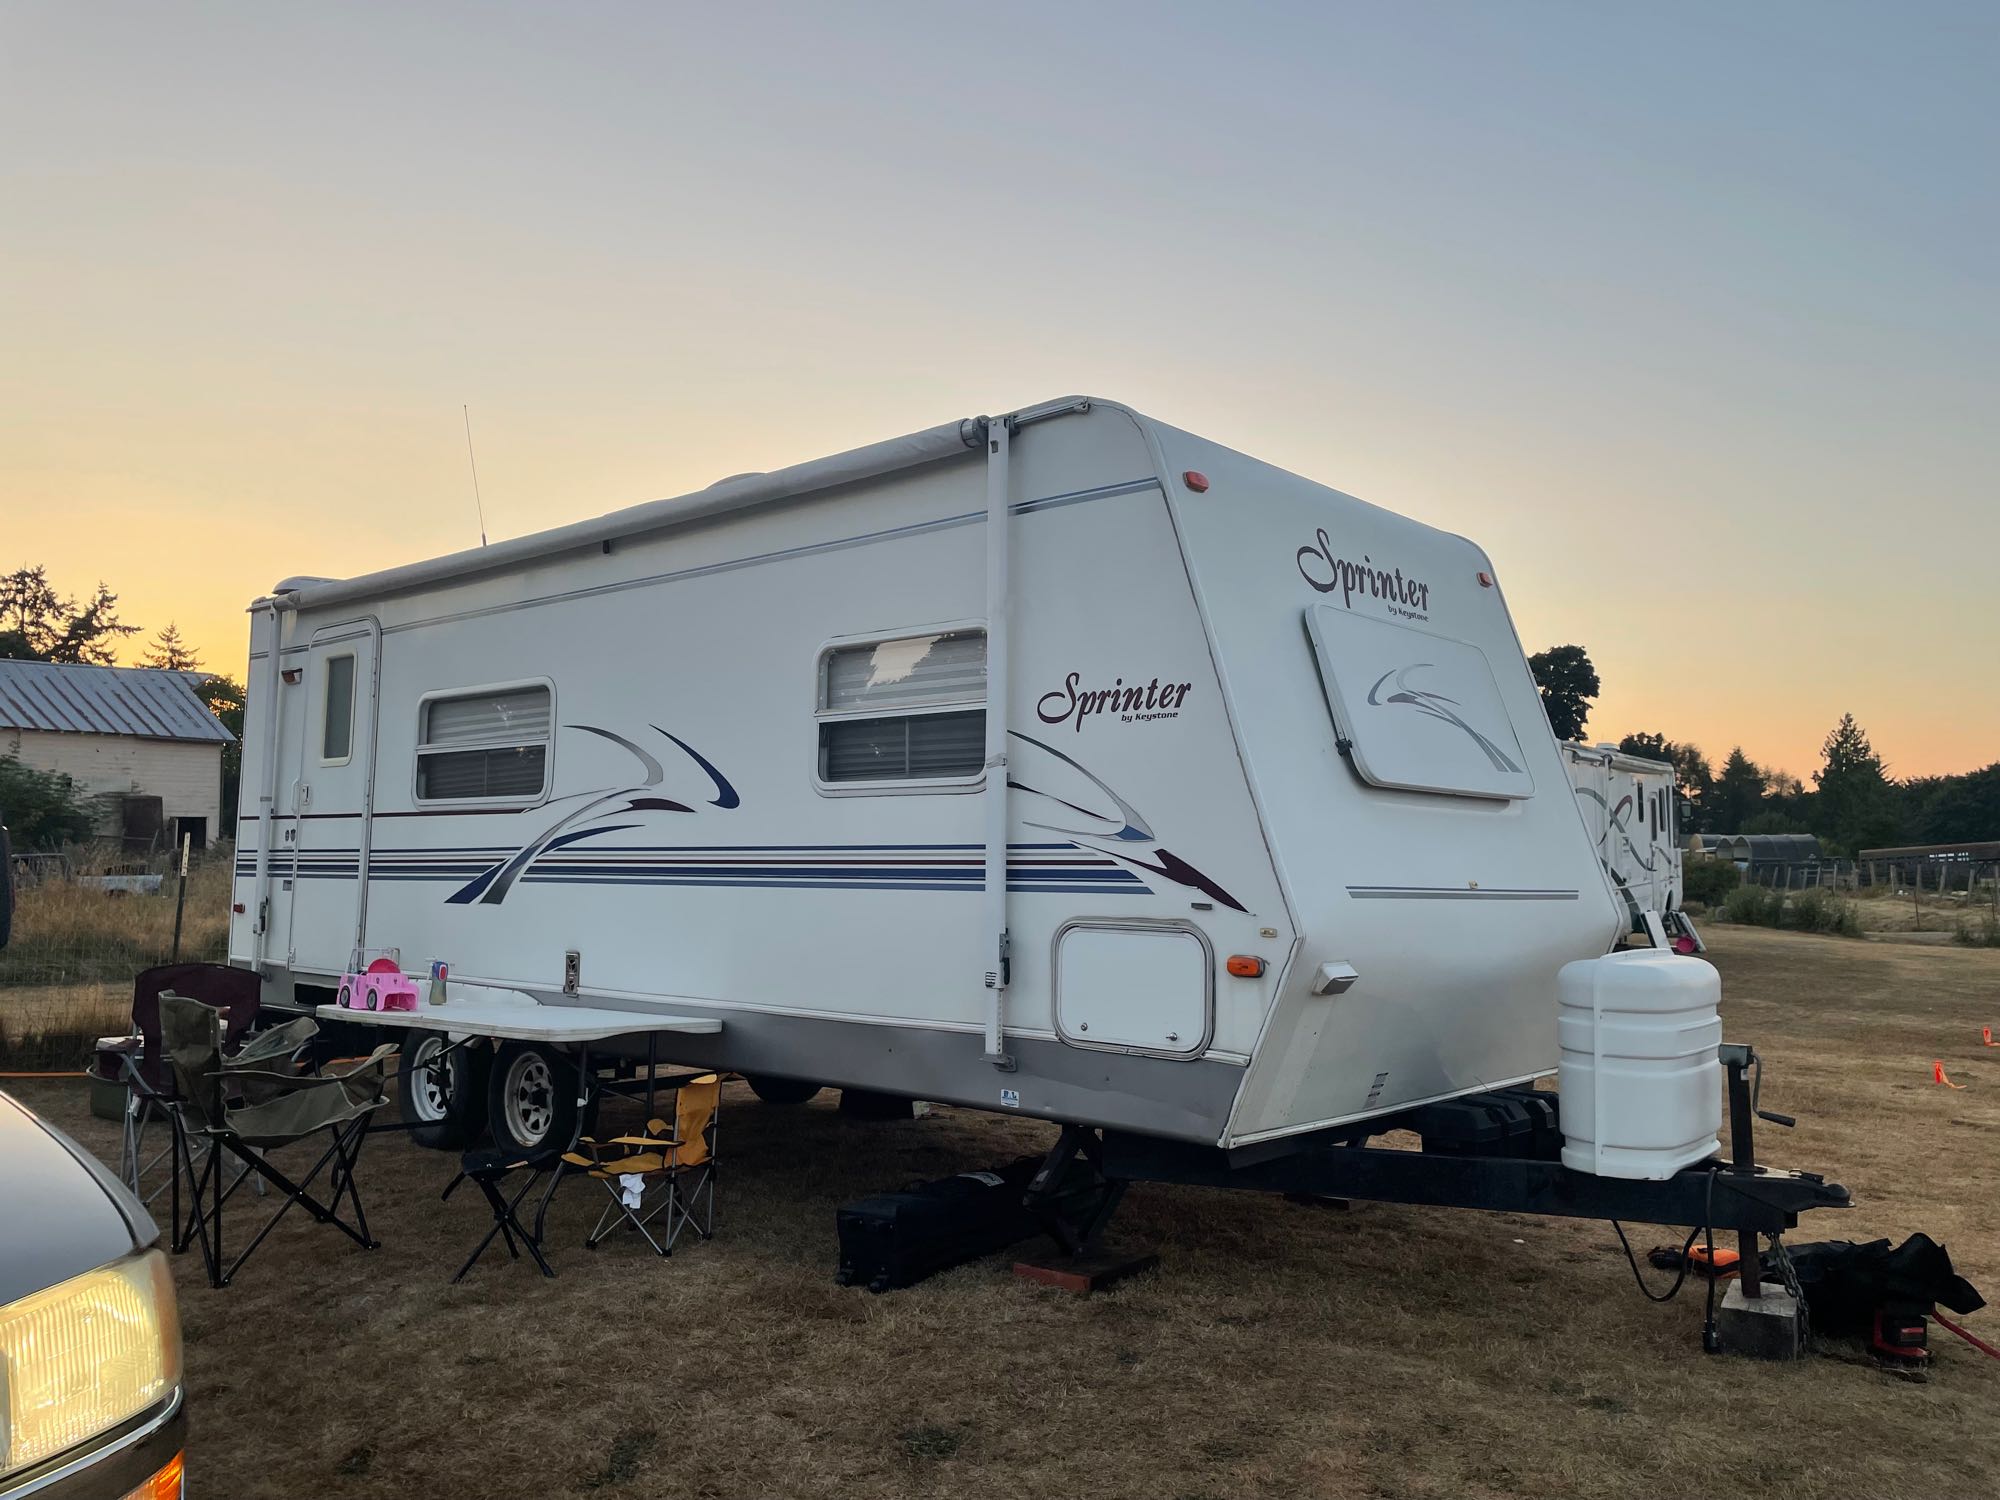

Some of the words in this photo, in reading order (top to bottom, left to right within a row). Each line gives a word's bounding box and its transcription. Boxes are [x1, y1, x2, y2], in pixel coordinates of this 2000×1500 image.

[1297, 528, 1429, 611] Sprinter
[1388, 604, 1398, 616] by
[1399, 608, 1429, 622] Keystone
[1037, 672, 1192, 733] Sprinter
[1121, 714, 1133, 723] by
[1135, 712, 1179, 722] Keystone
